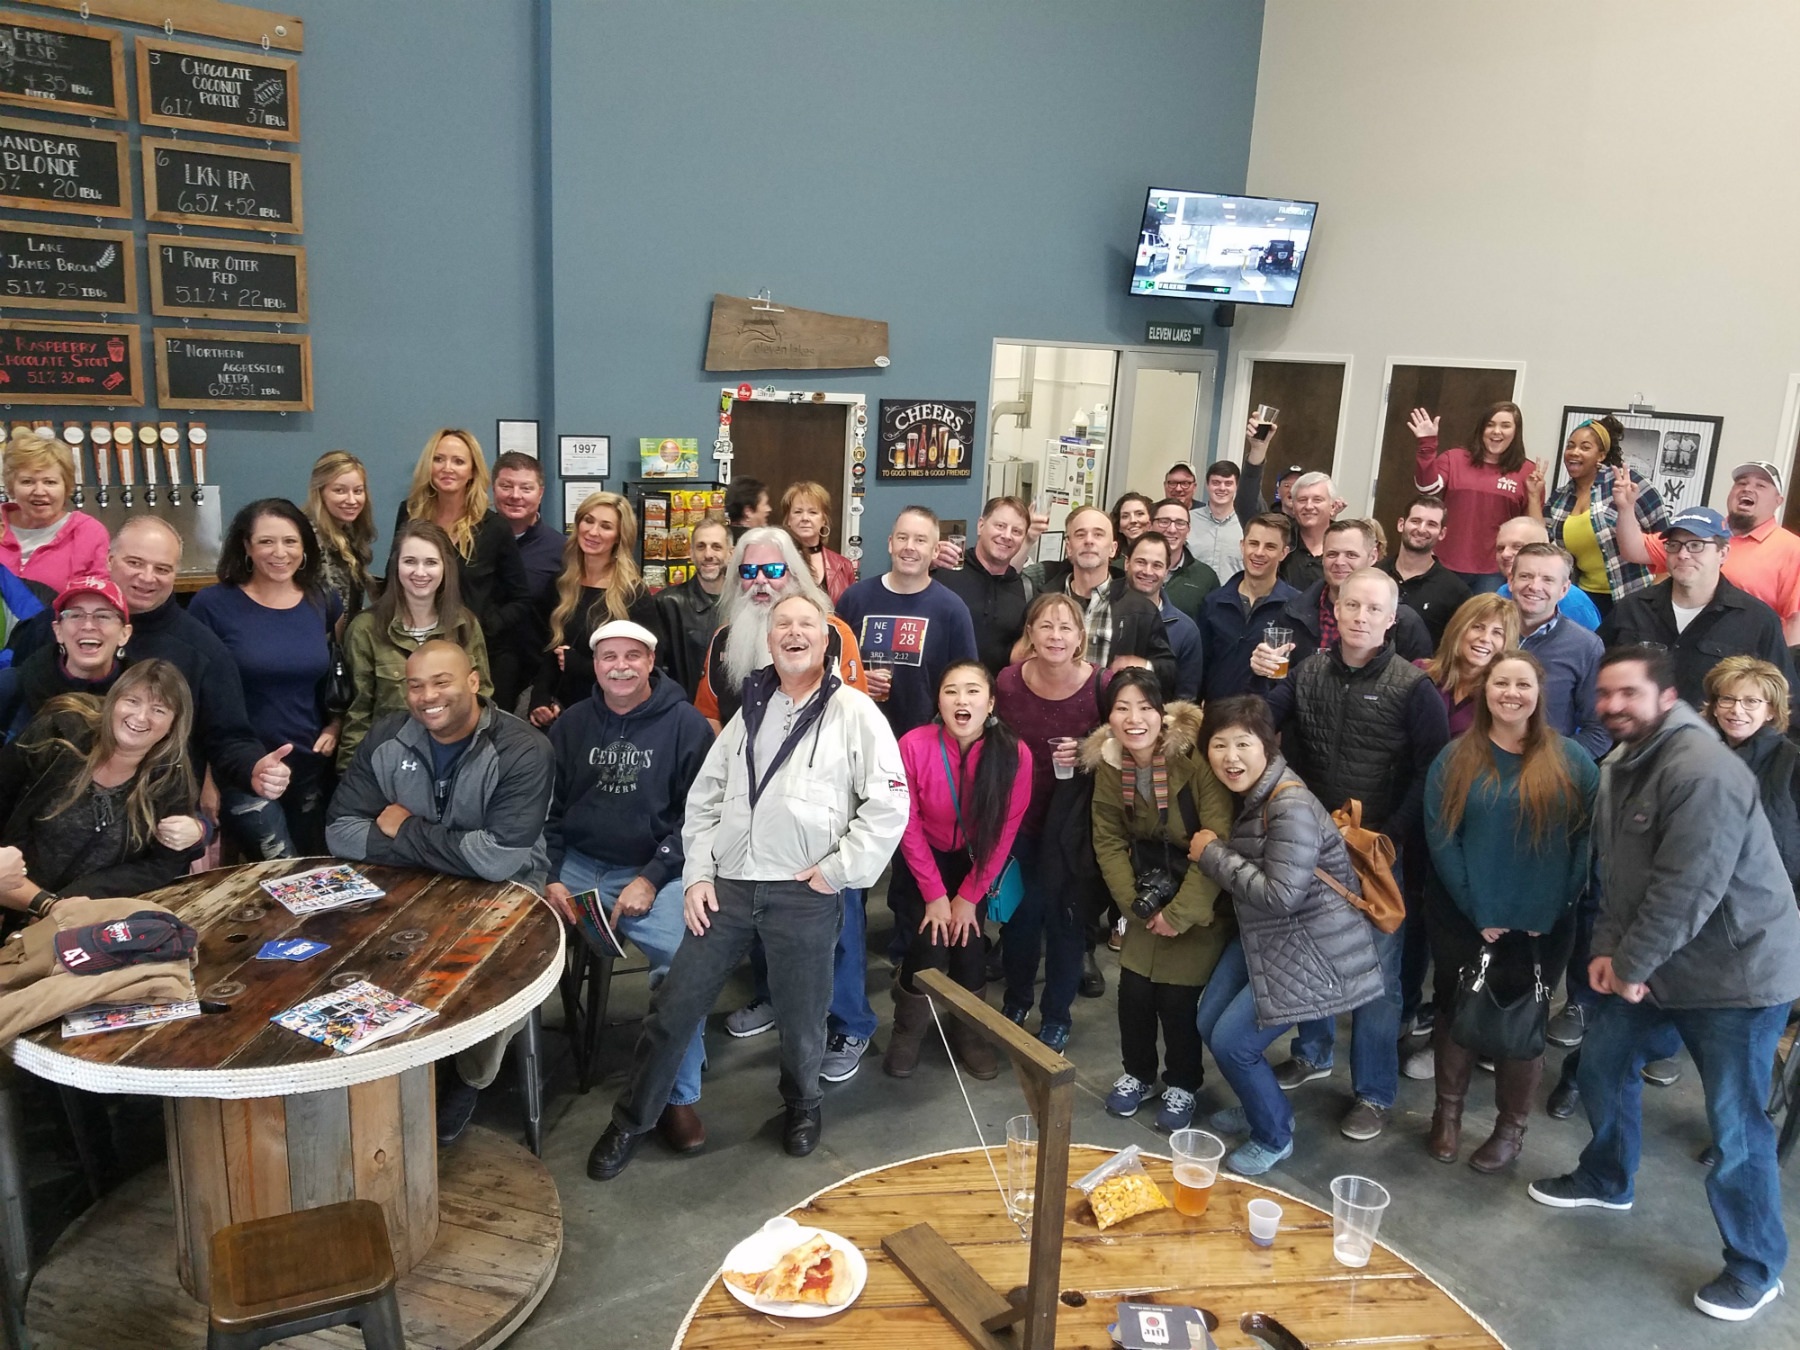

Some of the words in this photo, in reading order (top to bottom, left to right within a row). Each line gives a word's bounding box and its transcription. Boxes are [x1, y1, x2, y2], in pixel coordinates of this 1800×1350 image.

[25, 43, 58, 60] ESB
[150, 53, 160, 65] 3
[181, 58, 253, 81] CHOCOLATE
[43, 74, 67, 91] 35
[192, 77, 242, 95] COCONUT
[199, 92, 240, 108] PORTER
[247, 107, 265, 123] 37
[0, 135, 80, 157] ANDBAR
[3, 152, 79, 177] BLONDE
[157, 150, 169, 166] 6
[185, 163, 220, 187] LKN
[227, 170, 256, 191] IPA
[53, 179, 77, 198] 20
[236, 197, 259, 217] 52
[27, 237, 65, 253] LAKE
[8, 254, 51, 270] JAMES
[162, 247, 173, 263] 9
[183, 251, 220, 270] RIVER
[225, 256, 259, 272] OTTER
[212, 271, 238, 285] RED
[57, 282, 79, 297] 25
[238, 289, 263, 307] 22
[1149, 326, 1172, 341] ELEVEN
[1172, 328, 1192, 342] LAKES
[16, 336, 97, 353] RASPBERRY
[167, 340, 182, 353] 12
[185, 344, 245, 358] NORTHERN
[70, 354, 110, 368] STOUT
[223, 362, 285, 374] AGGRESSION
[61, 371, 75, 384] 32
[241, 383, 257, 396] 51
[895, 404, 964, 432] CHEERS
[573, 443, 597, 454] 1997
[890, 469, 907, 477] GOOD
[908, 469, 924, 477] TIMES
[930, 469, 945, 477] GOOD
[873, 621, 888, 630] NE
[900, 622, 918, 632] ATL
[874, 632, 883, 644] 3
[899, 633, 916, 645] 28
[588, 746, 654, 769] CEDRIC'S
[596, 780, 637, 794] TAVERN
[62, 947, 91, 967] 47
